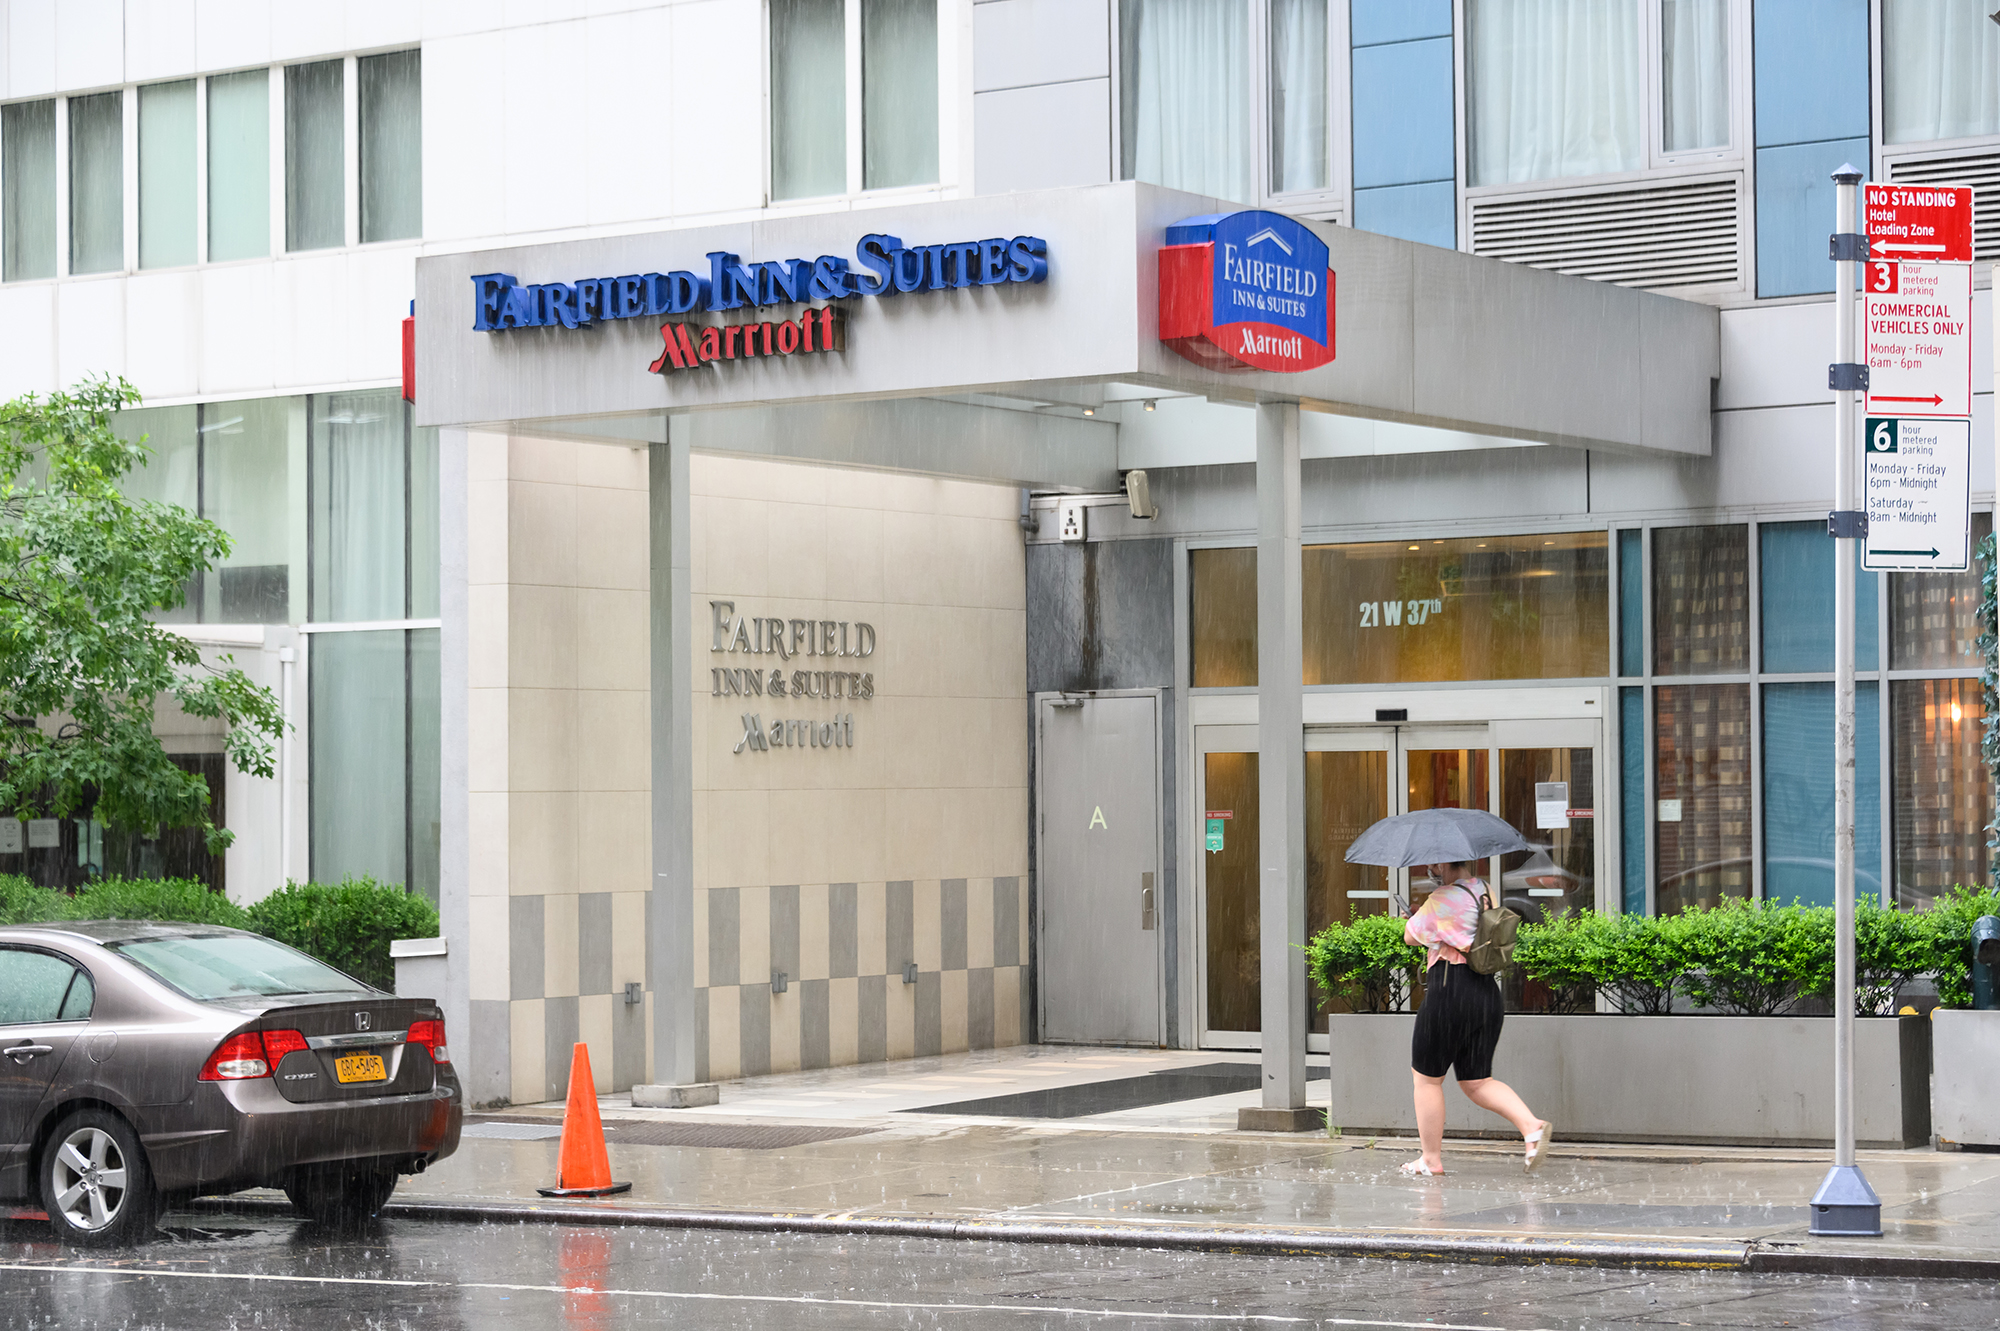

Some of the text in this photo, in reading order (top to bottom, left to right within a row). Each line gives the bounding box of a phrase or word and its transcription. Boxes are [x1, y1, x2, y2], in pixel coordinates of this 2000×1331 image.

[1869, 190, 1956, 207] NO STANDING
[1869, 209, 1896, 221] Hotel
[1869, 223, 1935, 238] Loading Zone
[1223, 242, 1317, 298] FAIRFIELD
[1873, 262, 1891, 292] 3
[1903, 264, 1922, 274] hour
[471, 233, 1046, 332] FAIRFIELD INN & SUITES
[1903, 276, 1938, 286] metered
[1903, 286, 1934, 298] parking
[1232, 288, 1306, 318] INN & SUITES
[1870, 302, 1951, 318] COMMERCIAL
[1871, 320, 1964, 336] VEHICLES ONLY
[648, 304, 840, 374] Marriott
[1239, 327, 1303, 360] Marriott
[1870, 342, 1907, 356] Monday
[1915, 344, 1944, 358] Friday
[1870, 356, 1892, 368] 6am
[1900, 357, 1922, 371] 6pm
[1873, 421, 1891, 452] 6
[1902, 425, 1922, 434] hour
[1902, 436, 1938, 445] metered
[1902, 446, 1934, 457] parking
[1870, 463, 1908, 477] Monday
[1917, 463, 1947, 478] Friday
[1870, 477, 1891, 490] 6pm
[1899, 477, 1938, 491] Midnight
[1870, 497, 1914, 509] Saturday
[1869, 511, 1891, 523] 8am
[1899, 511, 1937, 526] Midnight
[1359, 599, 1442, 627] 21 W 37th
[709, 600, 876, 662] FAIRFIELD
[711, 667, 875, 700] INN & SUITES
[733, 712, 854, 754] Marriott
[1089, 805, 1108, 830] A
